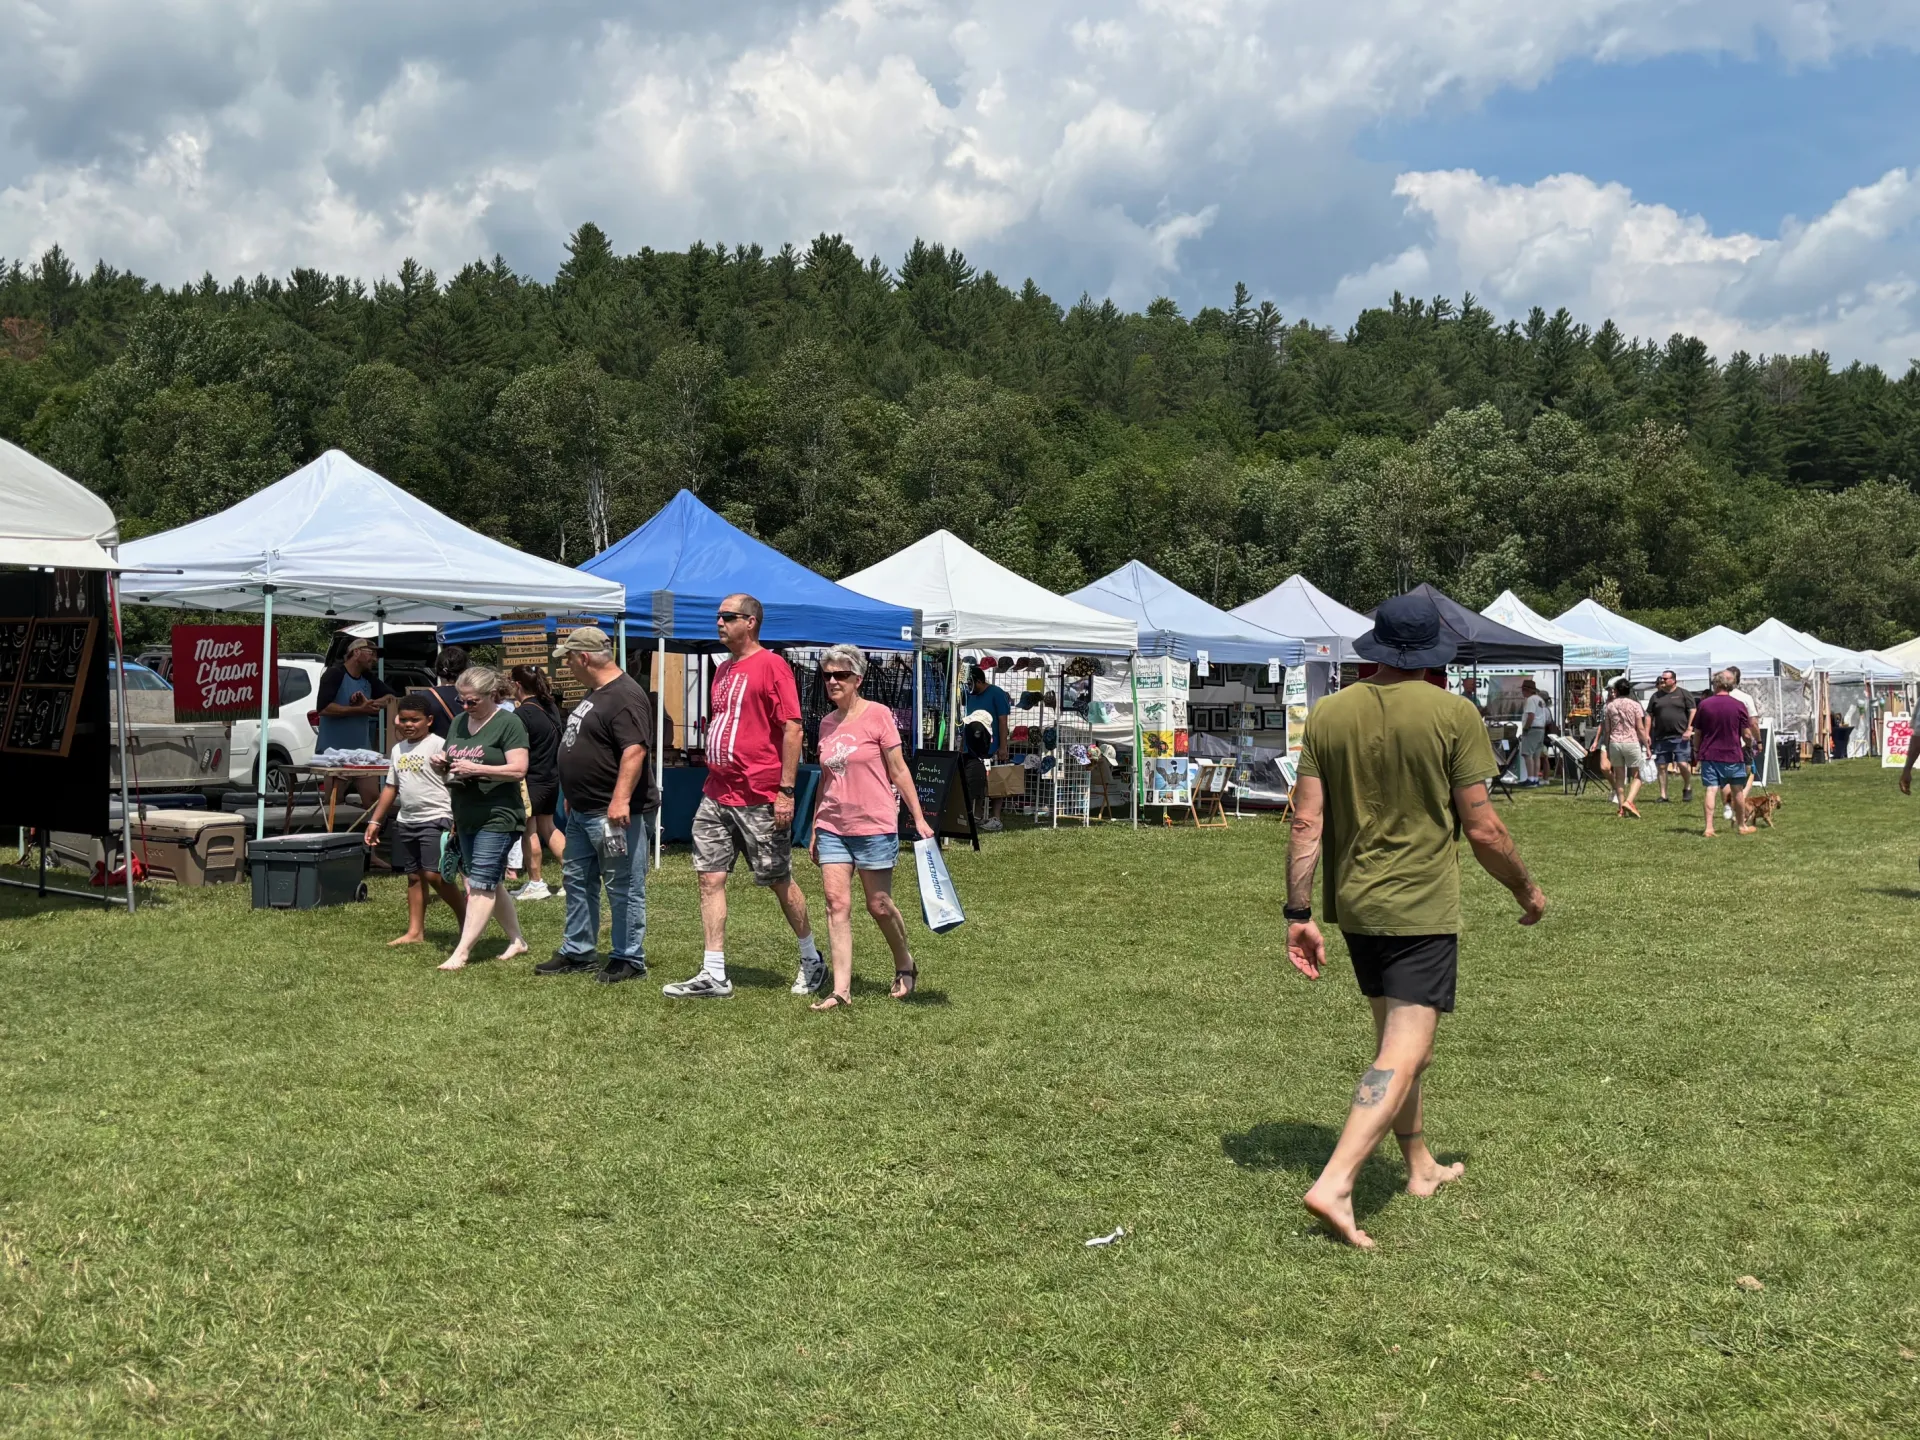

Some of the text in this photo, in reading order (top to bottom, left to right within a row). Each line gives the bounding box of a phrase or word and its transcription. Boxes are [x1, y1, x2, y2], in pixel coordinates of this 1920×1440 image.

[194, 639, 244, 661] Mace
[196, 661, 259, 686] Chasm
[1140, 676, 1160, 685] Original
[201, 683, 254, 709] Farm
[1887, 737, 1910, 747] BEE
[447, 744, 485, 758] Nashville
[917, 763, 941, 775] Cannabis
[916, 772, 946, 784] Pain Lotion
[925, 850, 944, 901] PROGRESSIVE
